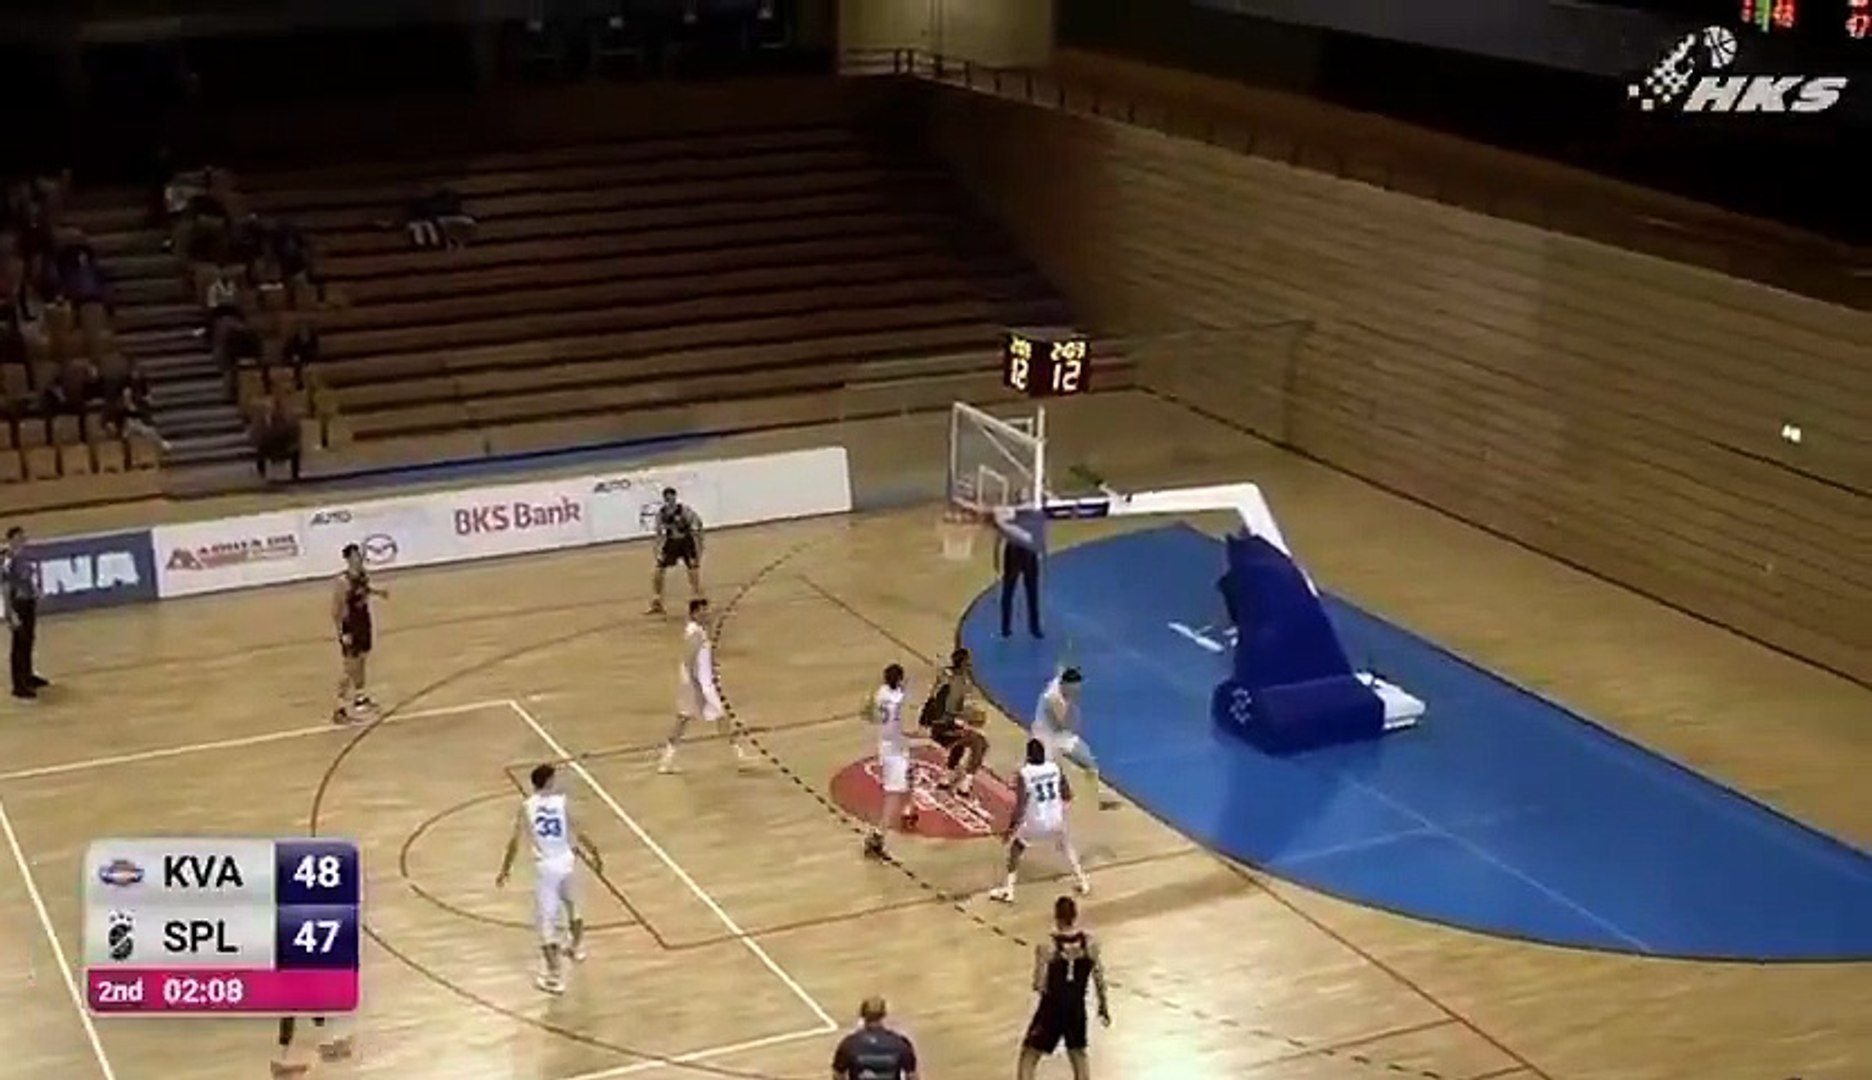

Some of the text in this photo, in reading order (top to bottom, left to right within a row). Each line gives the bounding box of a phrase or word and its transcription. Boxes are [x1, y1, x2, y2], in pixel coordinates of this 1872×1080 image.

[1053, 360, 1081, 390] 12
[454, 496, 581, 535] BKS Bank
